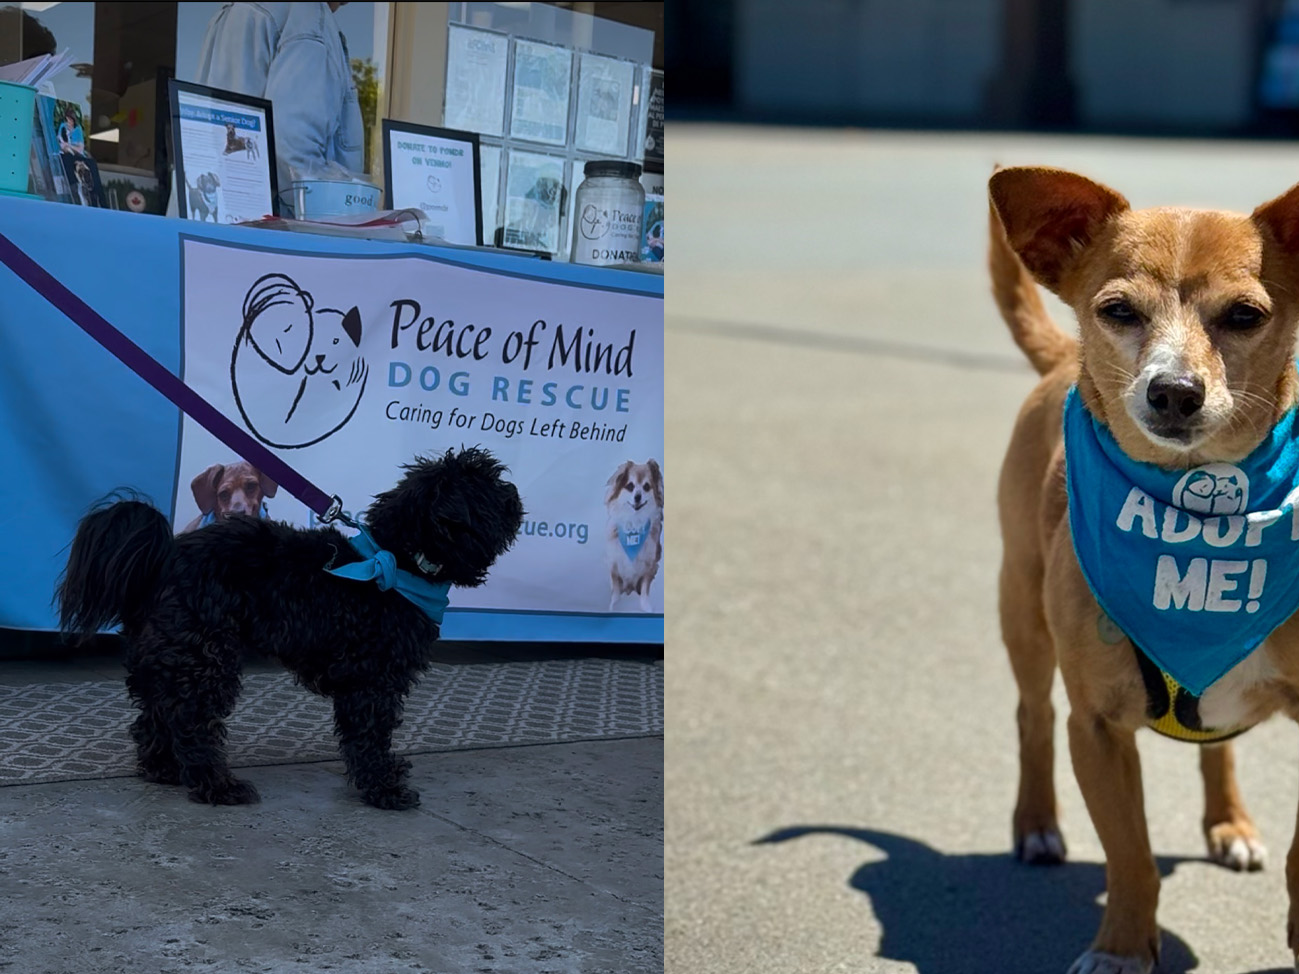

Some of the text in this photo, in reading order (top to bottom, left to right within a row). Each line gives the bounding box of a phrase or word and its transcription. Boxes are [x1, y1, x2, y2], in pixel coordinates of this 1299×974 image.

[397, 141, 425, 152] DONATE
[345, 194, 374, 207] good
[390, 299, 636, 377] Peace of Mind
[388, 361, 631, 413] DOG RESCUE
[386, 401, 627, 443] Caring for Dogs Left Behind
[1153, 554, 1268, 614] ME!
